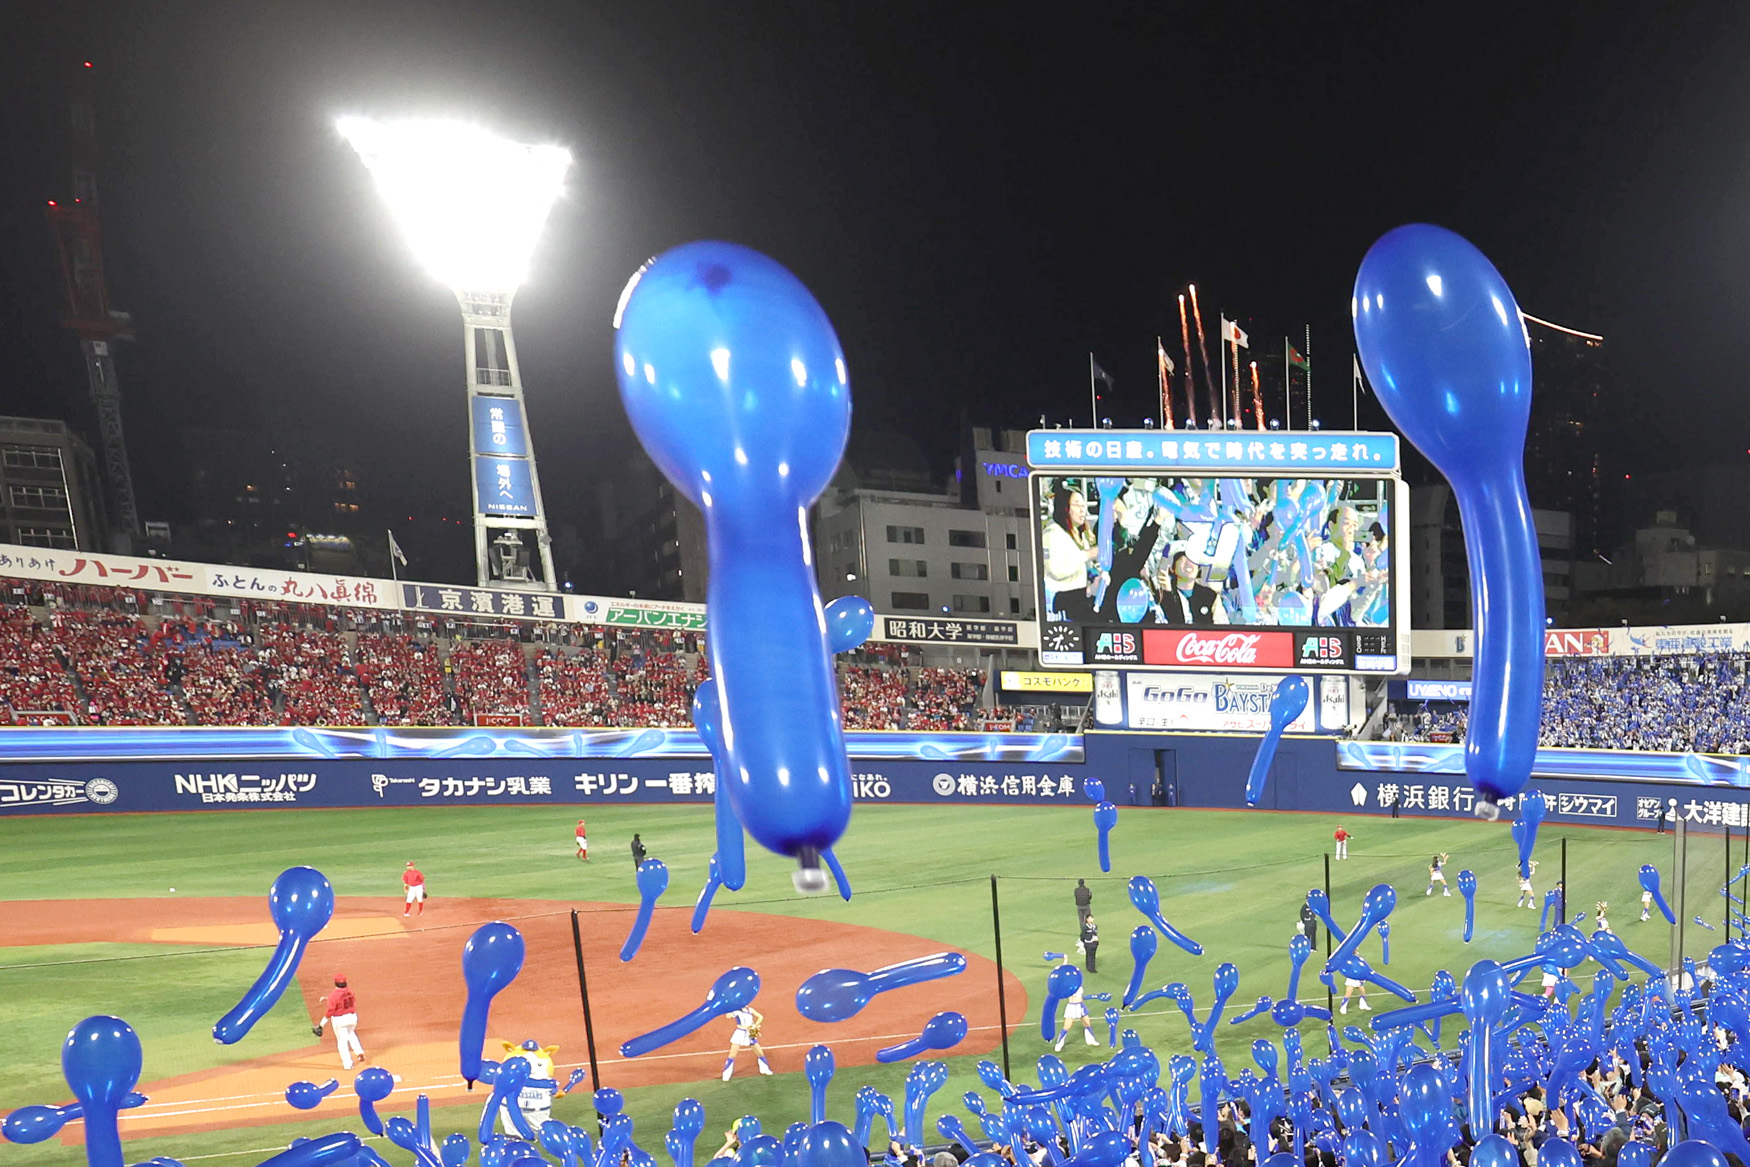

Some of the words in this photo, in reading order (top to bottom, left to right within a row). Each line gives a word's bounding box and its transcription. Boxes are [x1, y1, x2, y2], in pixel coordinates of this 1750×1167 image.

[983, 462, 1029, 479] YMCA
[488, 503, 528, 512] NISSAN
[0, 554, 56, 572] ありあけ
[59, 558, 194, 583] ハーバー
[889, 620, 963, 641] 昭和大学
[1175, 633, 1261, 664] Coca-Cola
[1023, 677, 1080, 688] コスモバンク
[1409, 684, 1457, 697] UYENO
[1143, 686, 1208, 703] GoGo
[1215, 683, 1271, 713] BAYST
[418, 776, 552, 797] タカナシ乳業
[957, 774, 1075, 797] 横浜信用金庫
[202, 791, 296, 803] 日本発条株式会社
[1377, 783, 1475, 812] 横浜銀行
